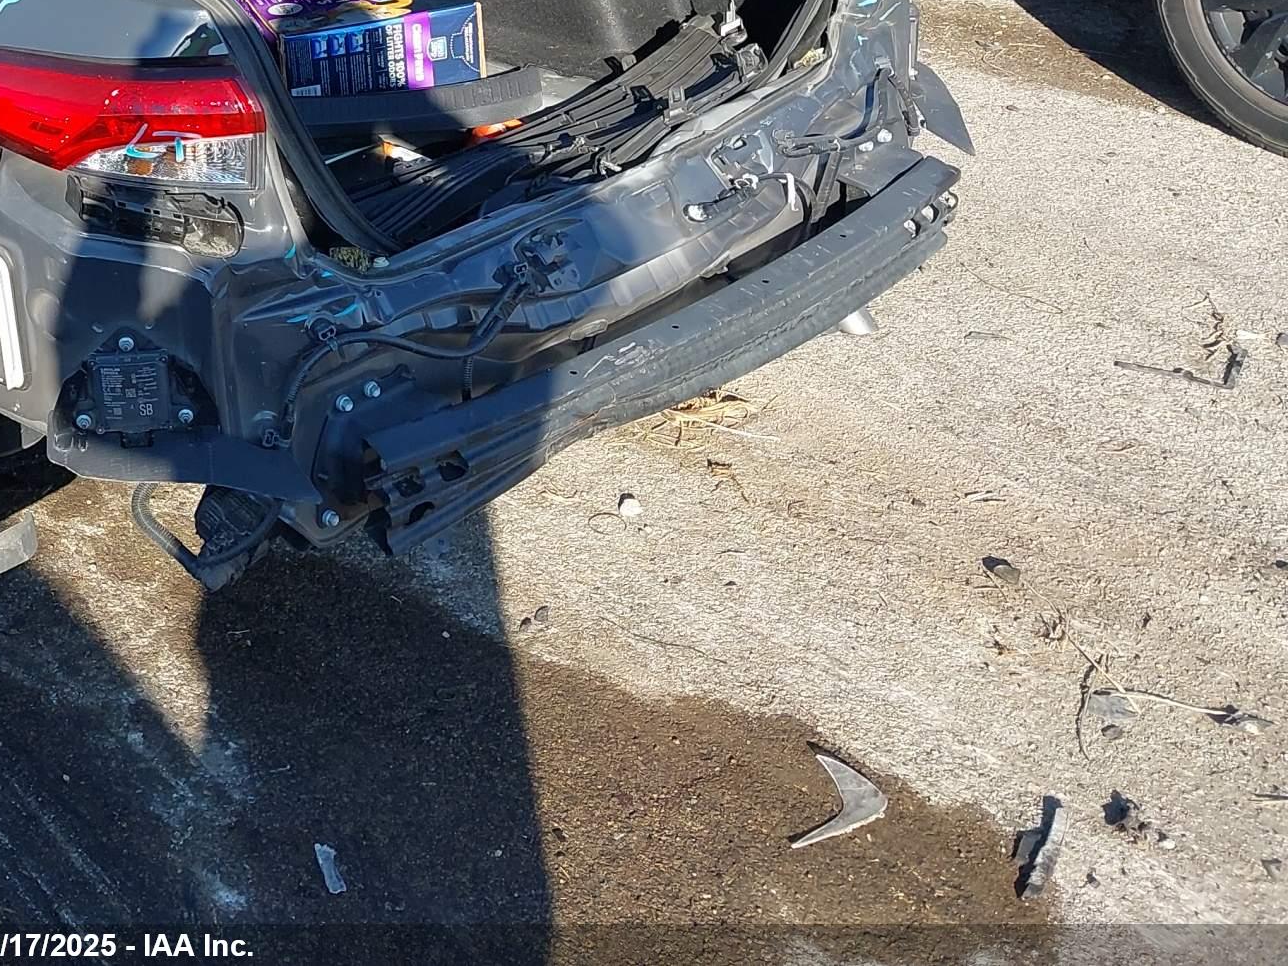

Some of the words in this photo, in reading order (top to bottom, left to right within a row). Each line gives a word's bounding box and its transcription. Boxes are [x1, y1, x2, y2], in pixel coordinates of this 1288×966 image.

[385, 24, 393, 35] OF
[386, 36, 395, 61] LITTER
[392, 24, 405, 61] FIGHTS
[388, 62, 396, 88] ODORS
[395, 61, 406, 88] 100%
[139, 403, 154, 416] SB
